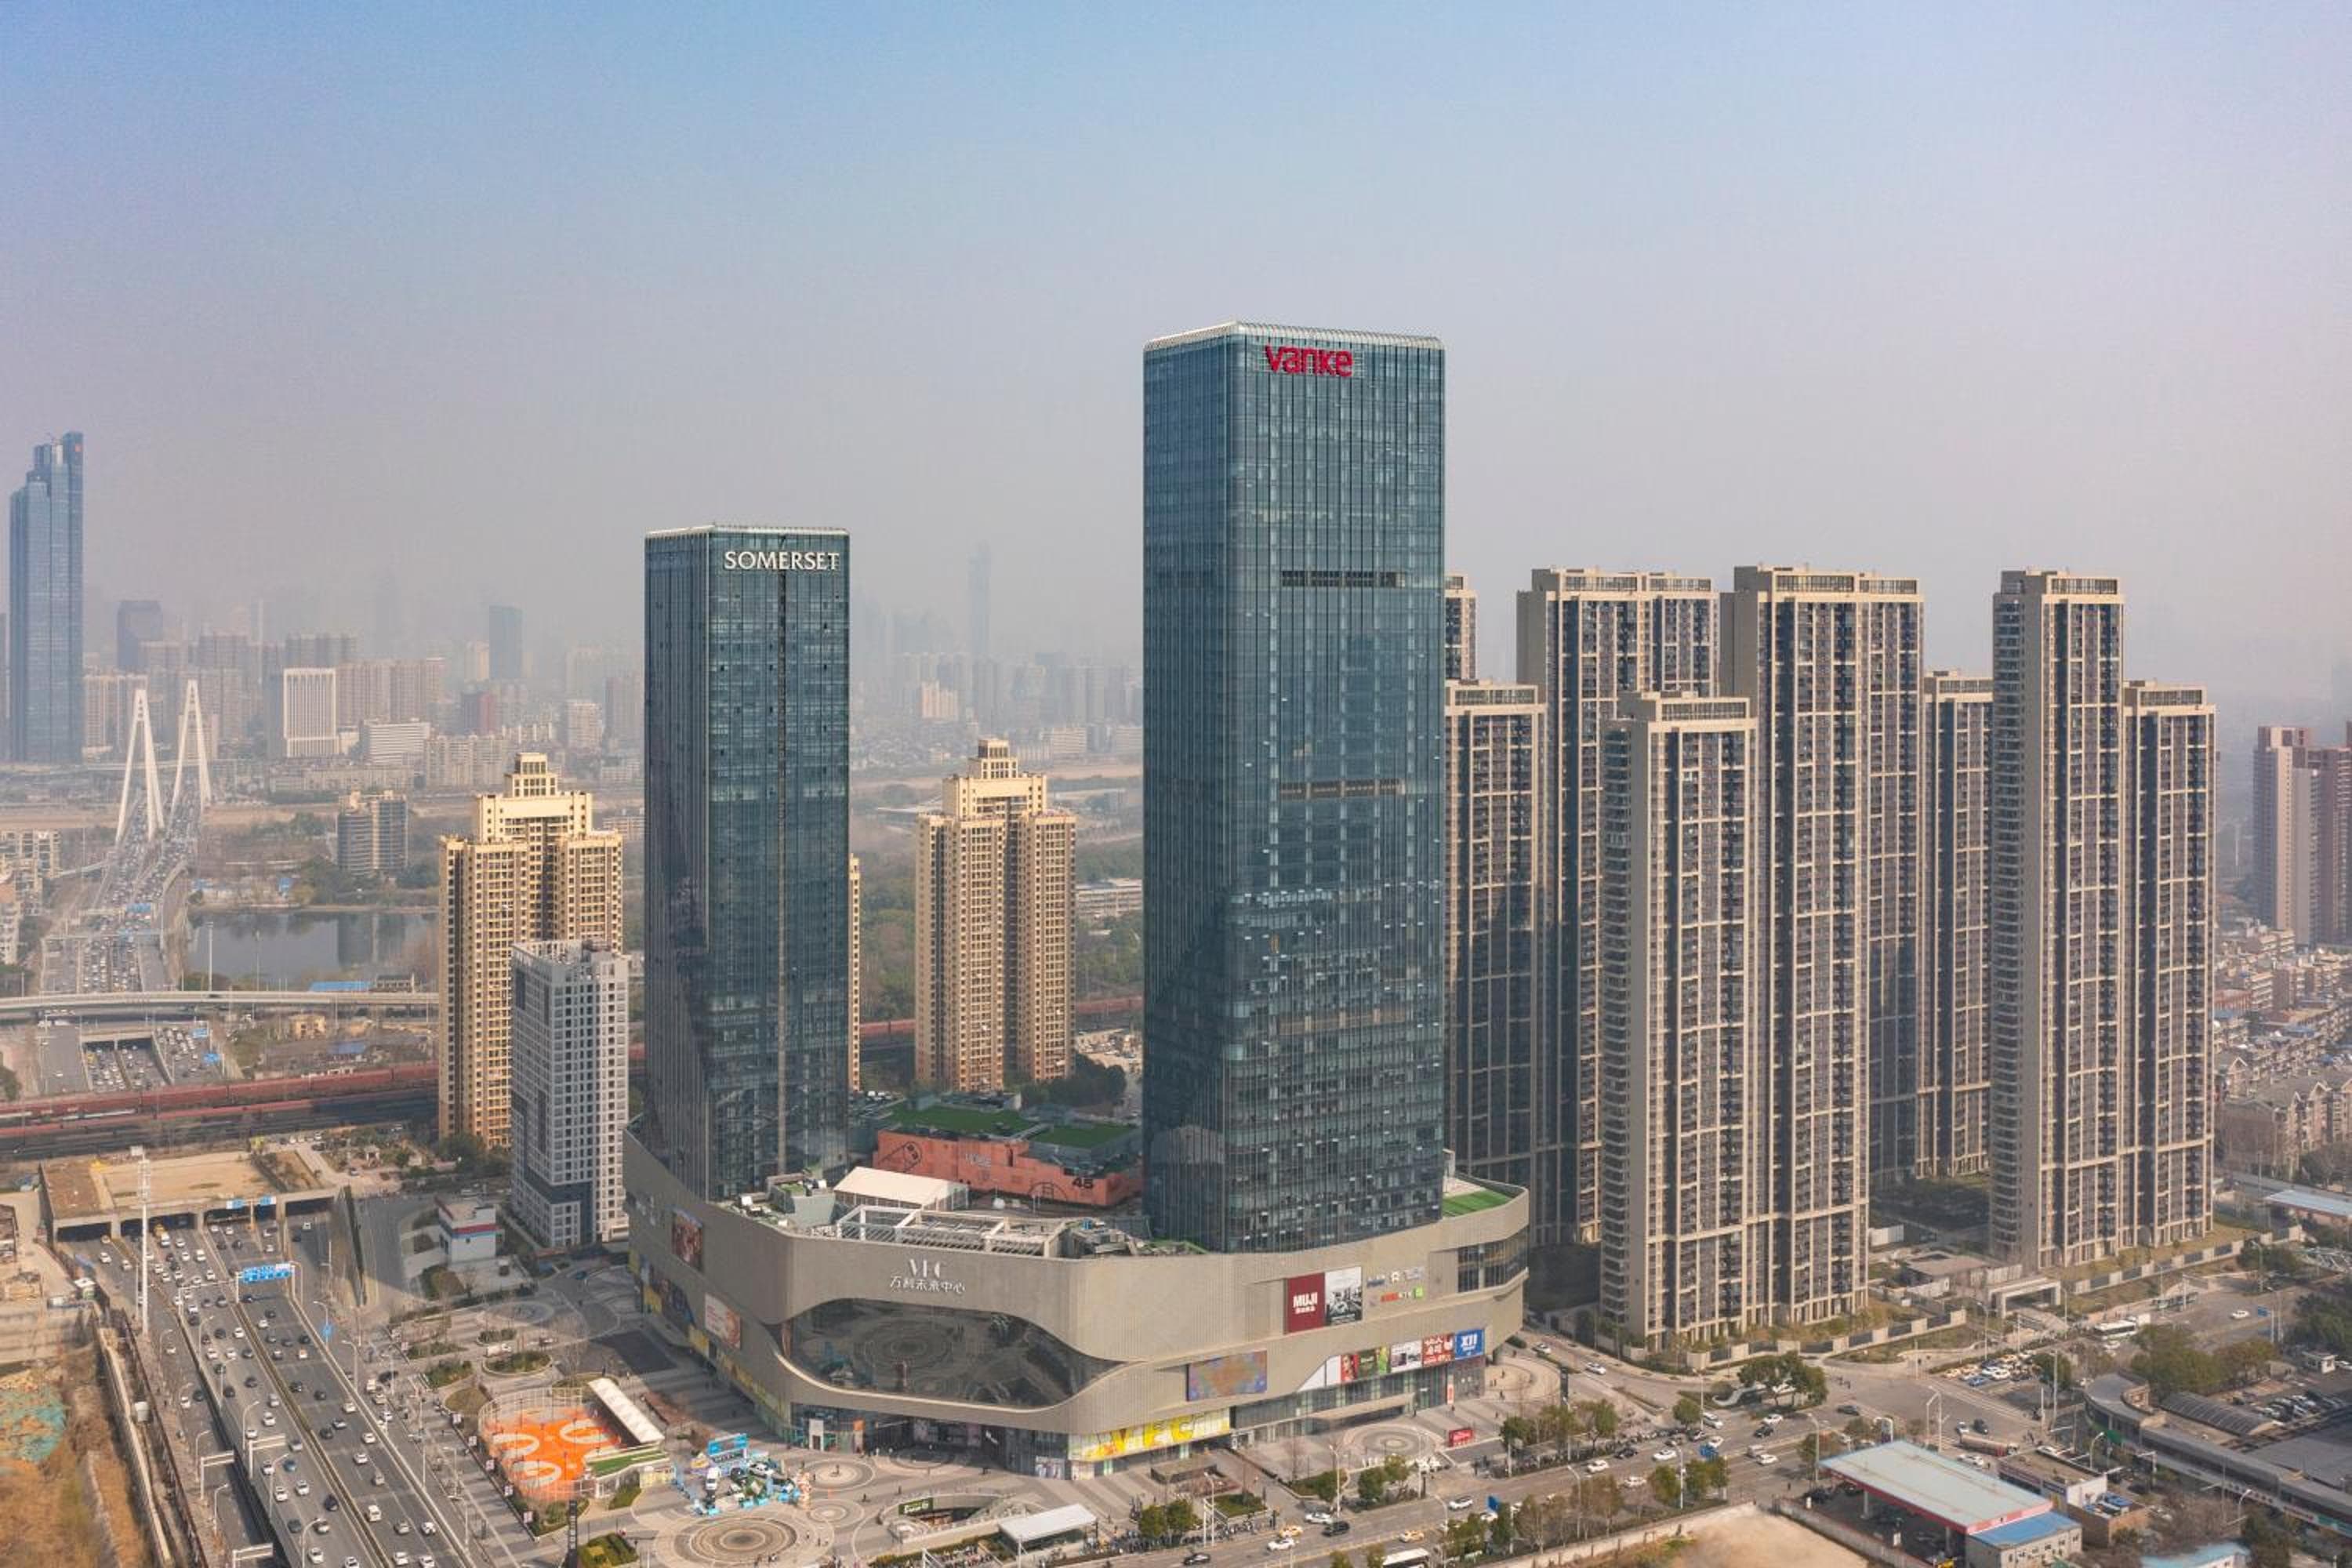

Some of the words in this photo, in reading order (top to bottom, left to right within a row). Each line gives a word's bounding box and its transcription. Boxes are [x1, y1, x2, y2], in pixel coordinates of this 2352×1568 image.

[1265, 345, 1353, 376] vanke
[724, 551, 840, 571] SOMERSET
[1293, 1291, 1318, 1308] MUJI
